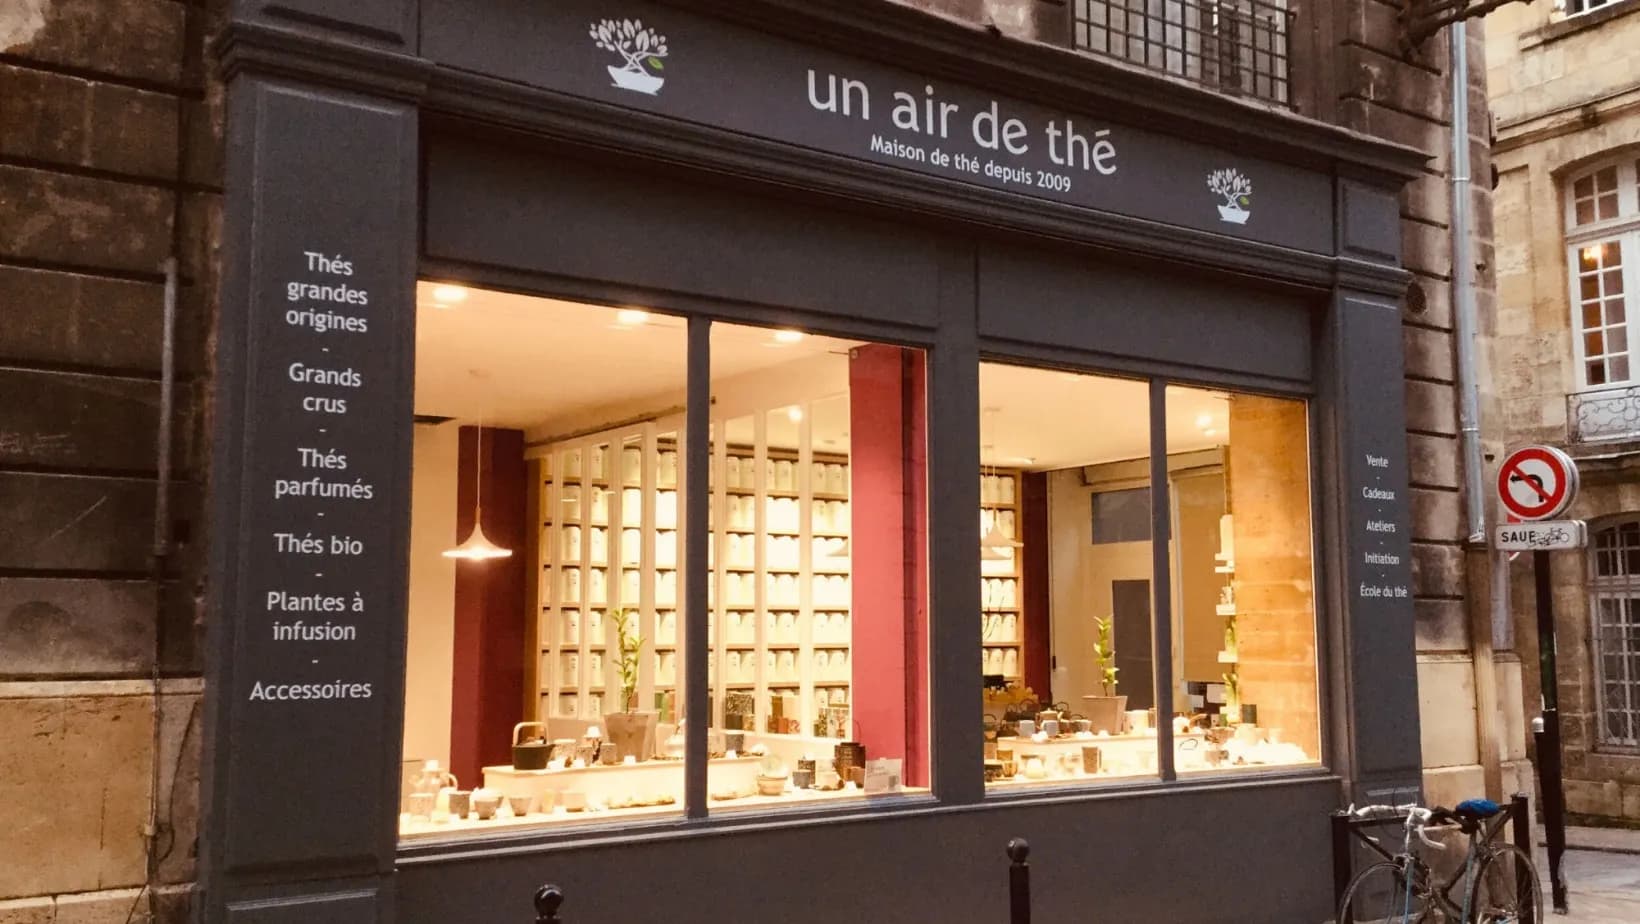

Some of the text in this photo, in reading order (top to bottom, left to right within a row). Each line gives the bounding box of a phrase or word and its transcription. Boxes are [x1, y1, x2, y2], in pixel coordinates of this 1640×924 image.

[808, 70, 1117, 174] un air de thé
[870, 134, 1072, 193] Maison de thé depuis 2009
[303, 251, 353, 276] Thés
[287, 281, 369, 306] grandes
[285, 307, 368, 333] origines
[288, 362, 362, 388] Grands
[302, 396, 347, 414] crus
[297, 447, 347, 470] Thés
[1365, 454, 1389, 468] Vente
[274, 476, 373, 500] parfumés
[1362, 486, 1395, 501] Cadeaux
[1366, 519, 1396, 533] Ateliers
[273, 532, 363, 556] Thés bio
[1364, 551, 1400, 565] Initiation
[1359, 582, 1408, 598] École du thé
[267, 591, 364, 612] Plantes à
[272, 620, 356, 641] infusion
[248, 679, 372, 701] Accessoires
